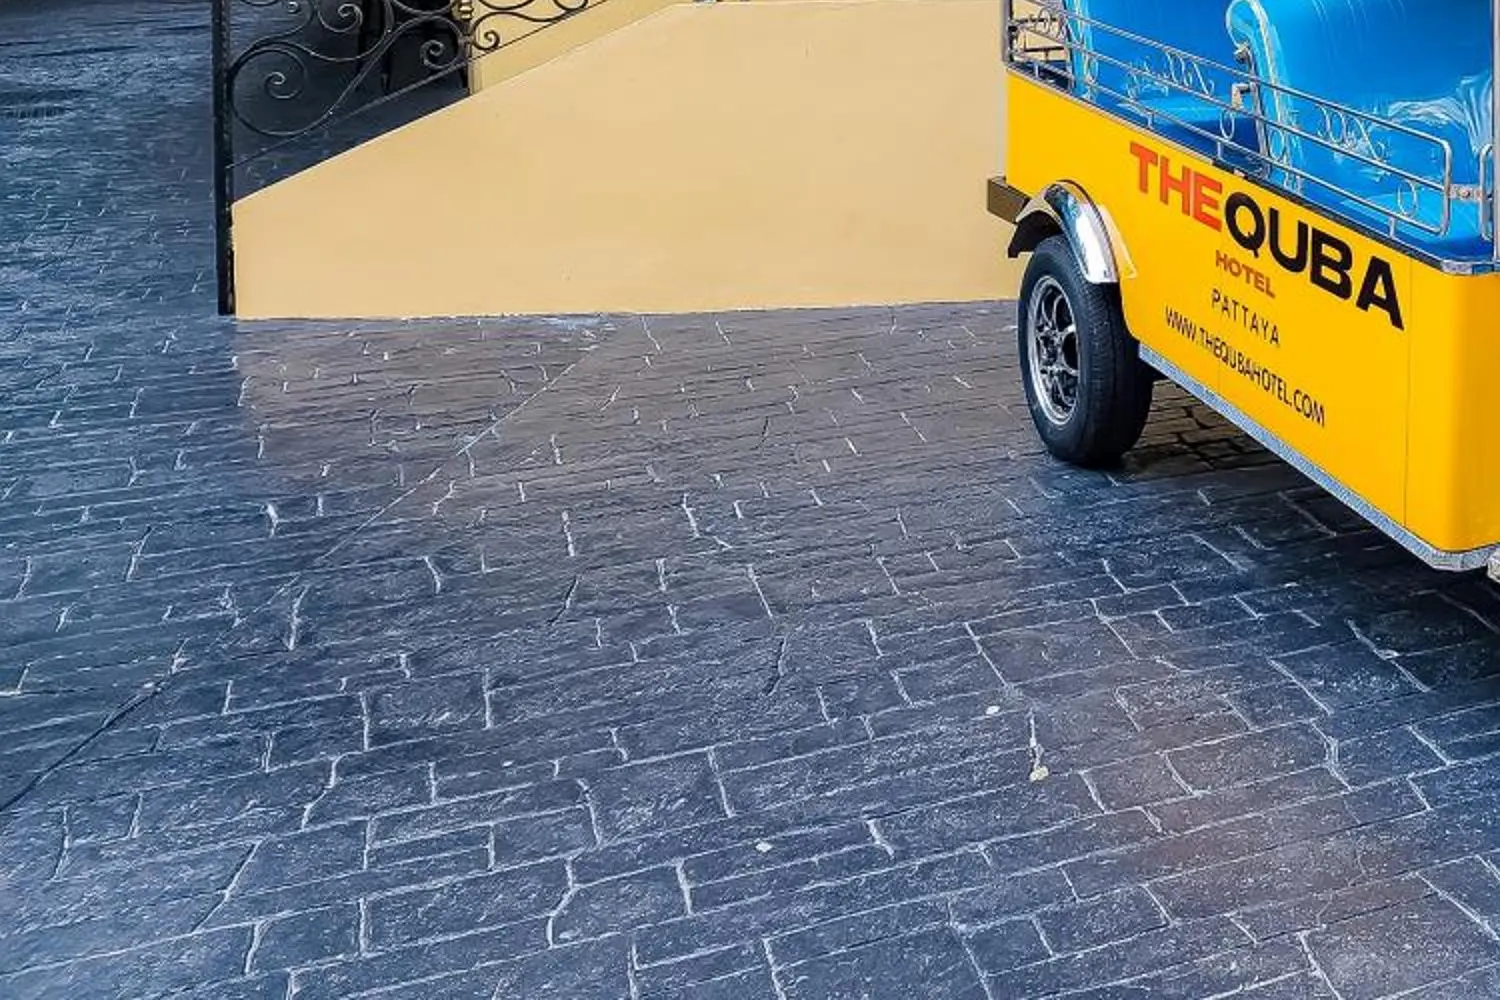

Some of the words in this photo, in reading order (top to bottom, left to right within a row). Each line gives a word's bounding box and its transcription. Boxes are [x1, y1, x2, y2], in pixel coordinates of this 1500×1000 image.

[1214, 249, 1276, 299] HOTEL
[1211, 288, 1281, 347] PATTAYA
[1164, 304, 1326, 429] WWW.THEQUBAHOTEL.COM
